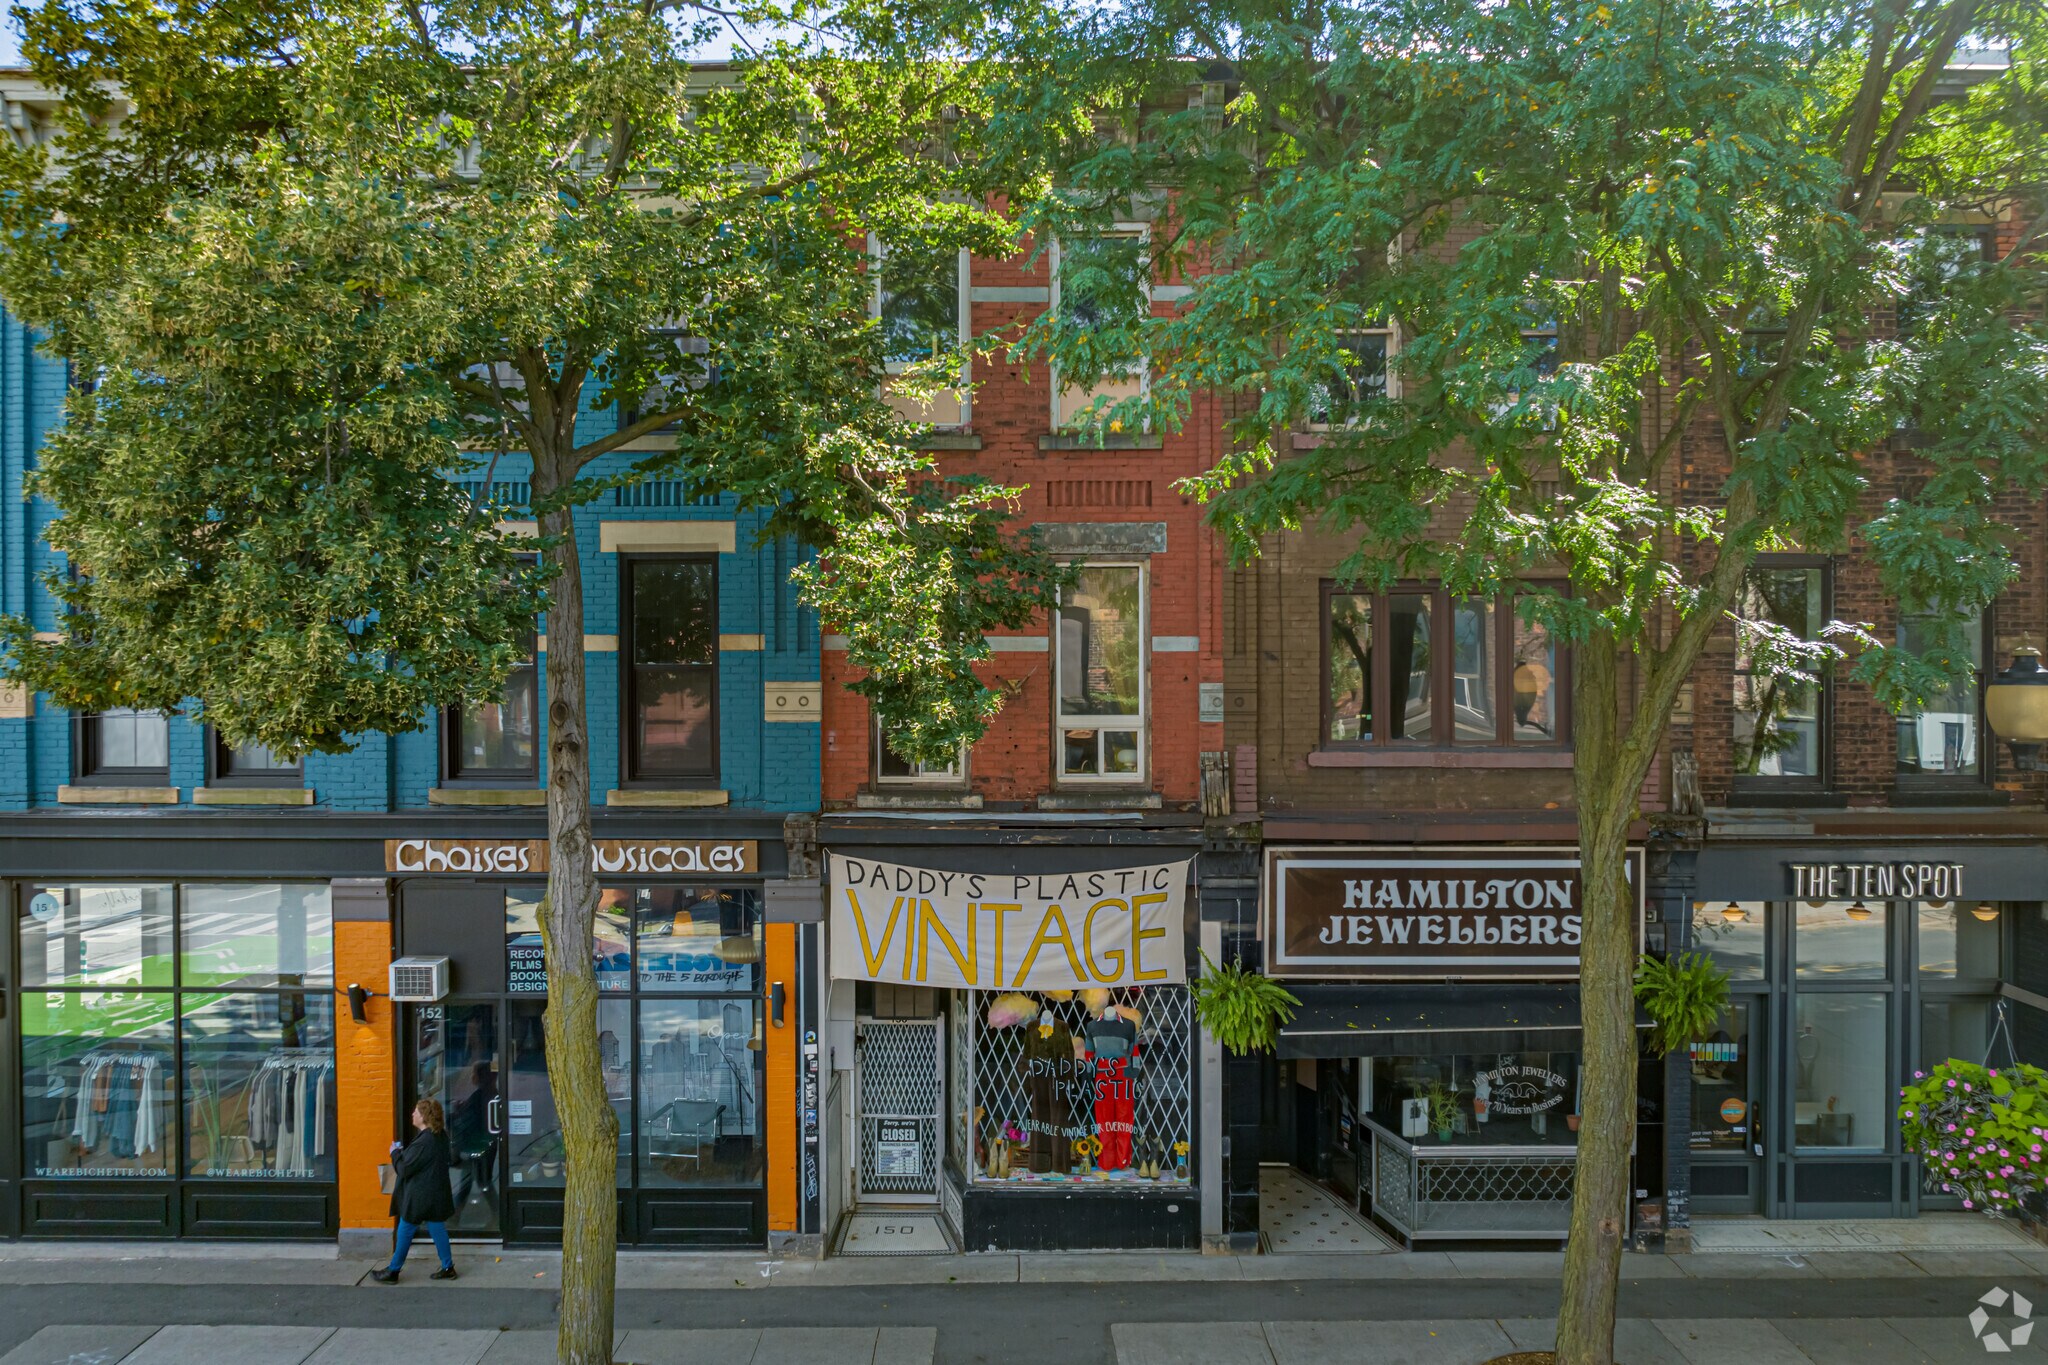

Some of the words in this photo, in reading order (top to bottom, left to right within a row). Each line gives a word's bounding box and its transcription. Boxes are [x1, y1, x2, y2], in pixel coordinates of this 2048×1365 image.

[397, 840, 529, 872] Chaises
[846, 860, 986, 899] DADDY'S
[1014, 868, 1169, 900] PLASTIC
[1792, 865, 1839, 898] THE
[1846, 864, 1894, 897] TEN
[1901, 864, 1964, 898] SPOT
[1343, 879, 1573, 909] HAMILTON
[845, 889, 1169, 988] VINTAGE
[1319, 915, 1582, 945] JEWELLERS
[510, 960, 542, 970] FILMS
[510, 971, 548, 981] BOOKS
[654, 972, 677, 982] THE
[680, 973, 691, 982] 5
[693, 970, 745, 984] BOROUGHS
[419, 1007, 442, 1019] 152
[707, 1024, 757, 1046] Open
[1029, 1056, 1119, 1079] DADDY'S
[1472, 1066, 1519, 1088] HAMILTON
[1521, 1066, 1567, 1088] JEWELLERS
[1055, 1078, 1143, 1101] PLASTIC
[1492, 1101, 1502, 1112] 70
[1503, 1102, 1522, 1115] Years
[1523, 1102, 1532, 1114] in
[1532, 1094, 1564, 1112] Business
[881, 1128, 916, 1141] CLOSED
[35, 1167, 167, 1177] WEAREBICHETTE.COM
[206, 1168, 315, 1178] @WEAREBICHETTE
[875, 1225, 914, 1235] 150
[1817, 1225, 1881, 1244] 146
